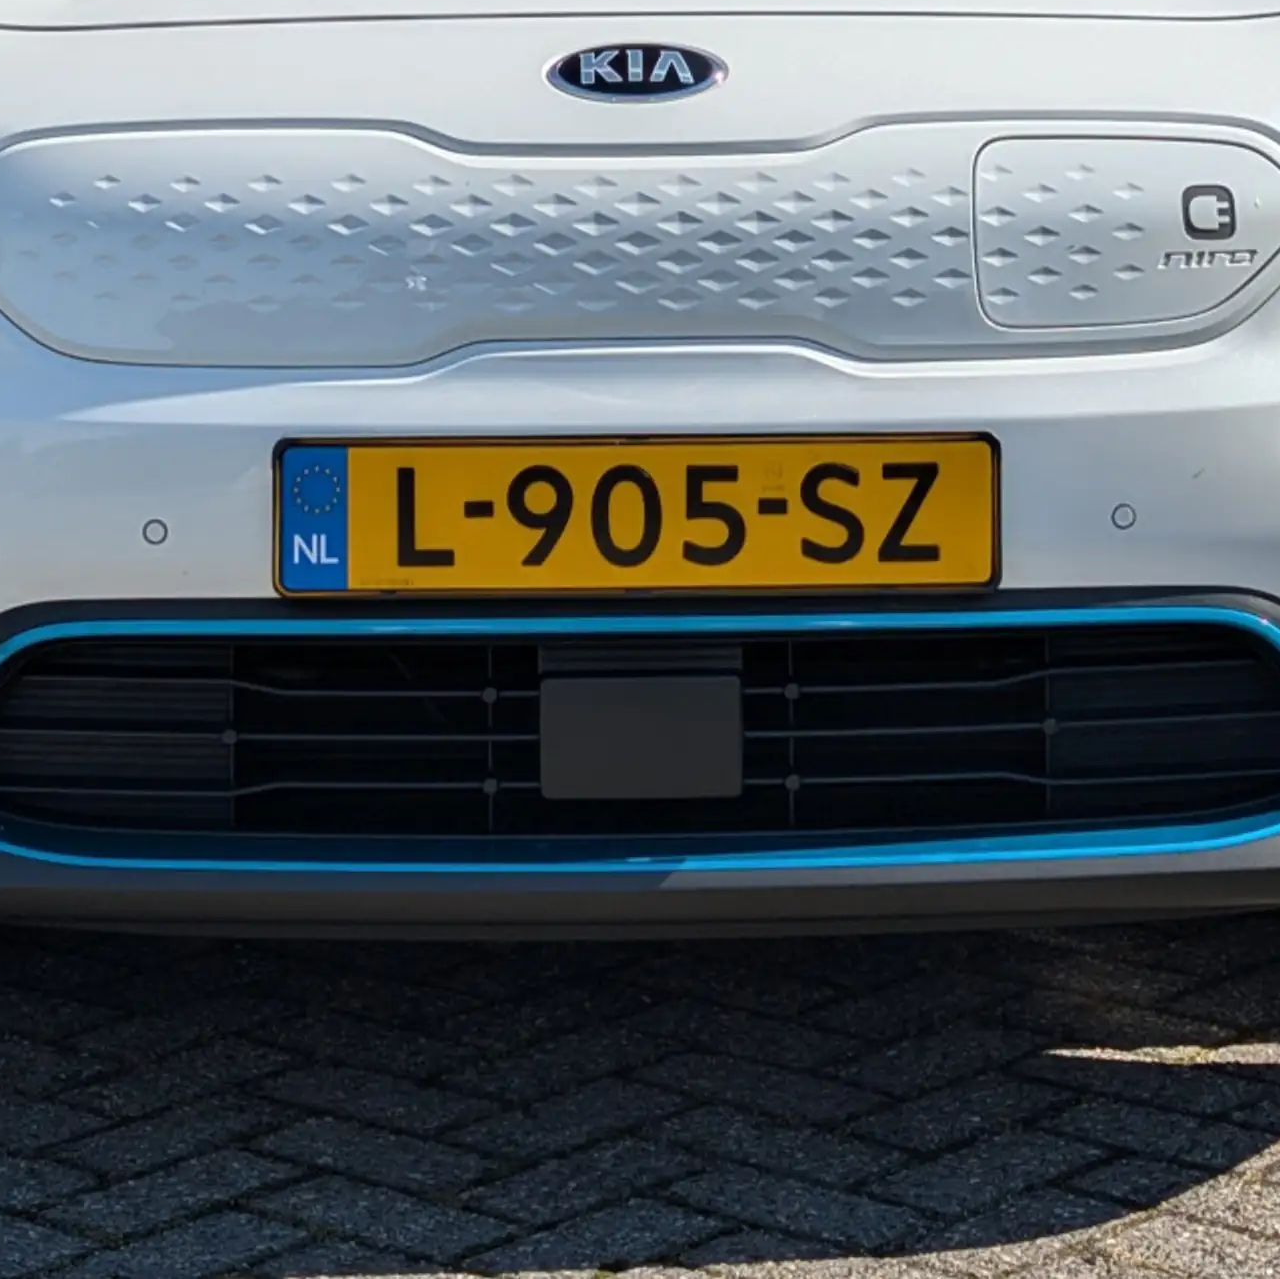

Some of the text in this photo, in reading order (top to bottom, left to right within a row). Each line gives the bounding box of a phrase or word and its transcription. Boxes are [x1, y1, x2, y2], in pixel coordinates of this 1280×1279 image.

[578, 48, 695, 85] KIA
[395, 462, 941, 568] L-905-SZ
[292, 533, 339, 566] NL
